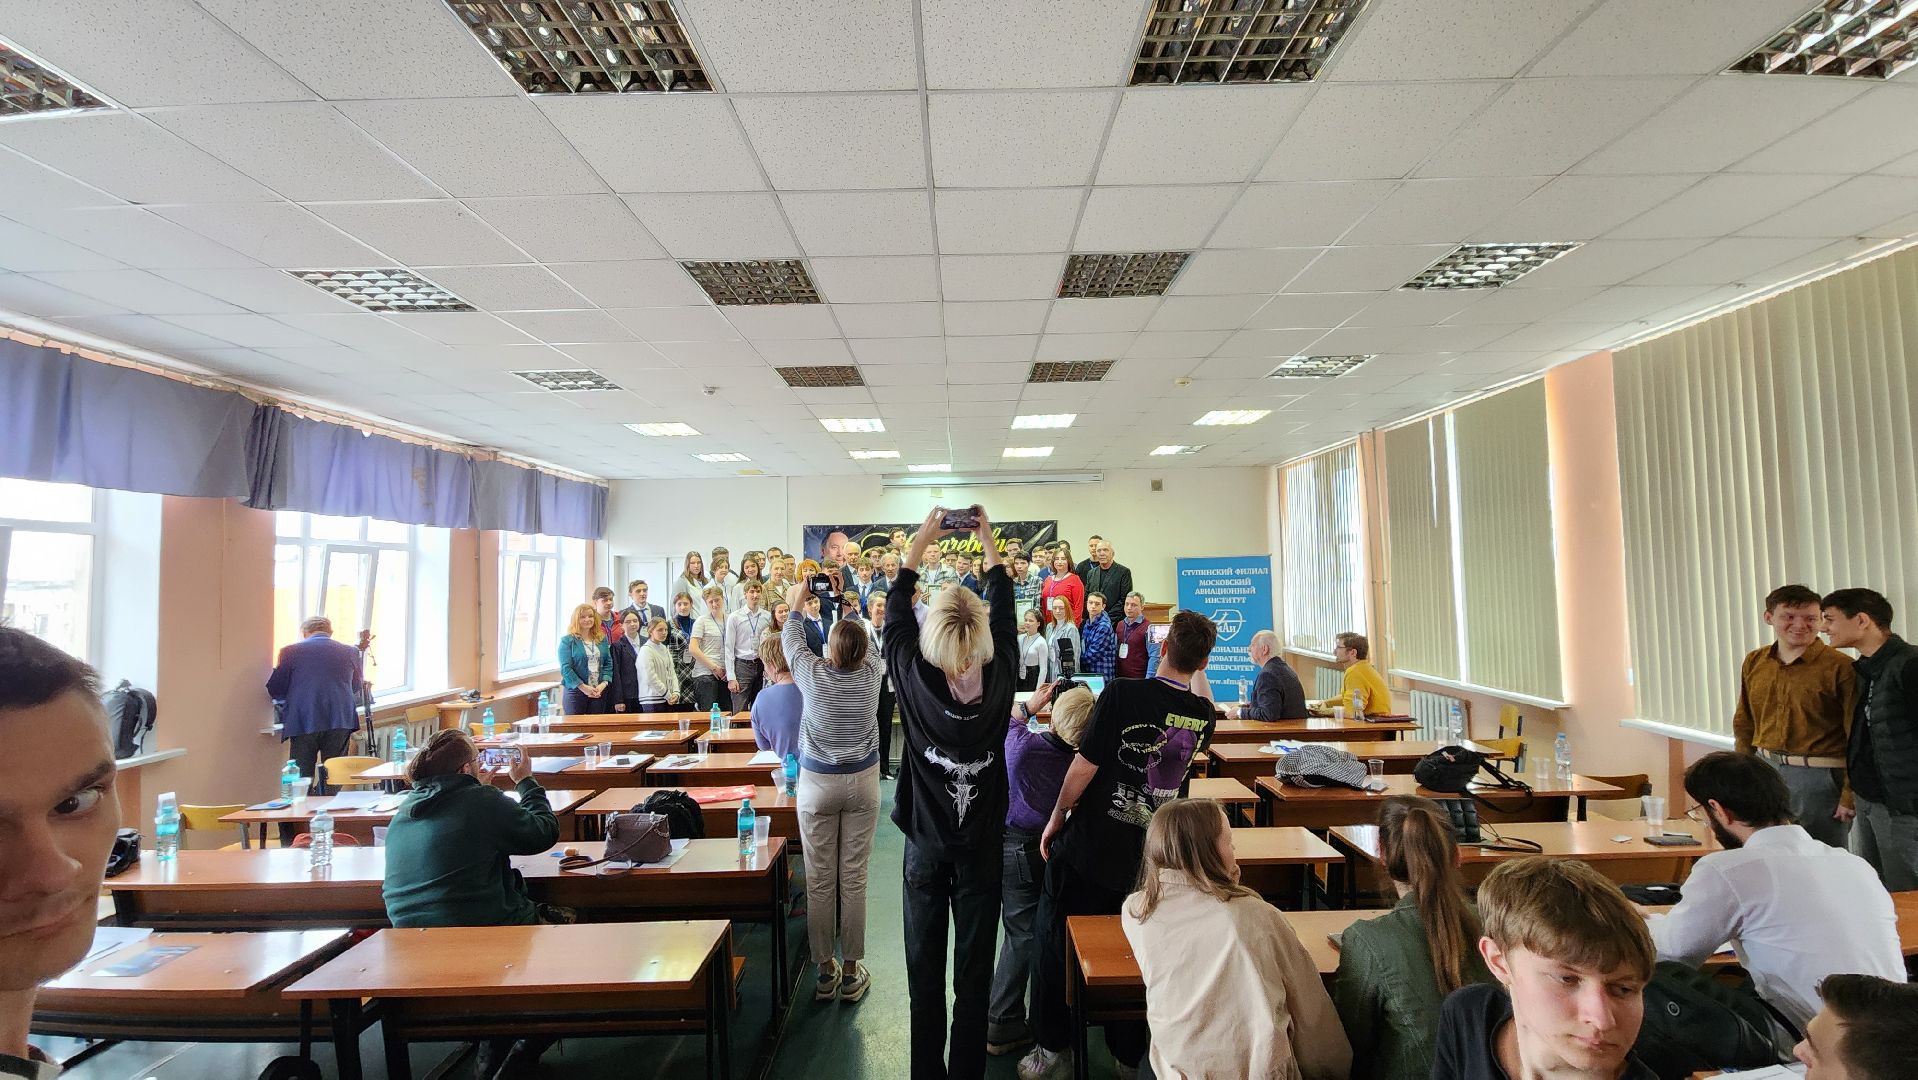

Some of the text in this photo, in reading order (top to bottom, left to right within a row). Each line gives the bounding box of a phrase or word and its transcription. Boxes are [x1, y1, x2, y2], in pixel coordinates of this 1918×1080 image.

[1182, 567, 1268, 576] СТУПИНСКИЙ ФИЛИАЛ
[1199, 578, 1251, 586] МОСКОВСКИЙ
[1195, 586, 1256, 595] АВИАЦИОННЫЙ
[1207, 664, 1255, 672] НИВЕРСИТЕТ
[1165, 712, 1208, 732] EVERY
